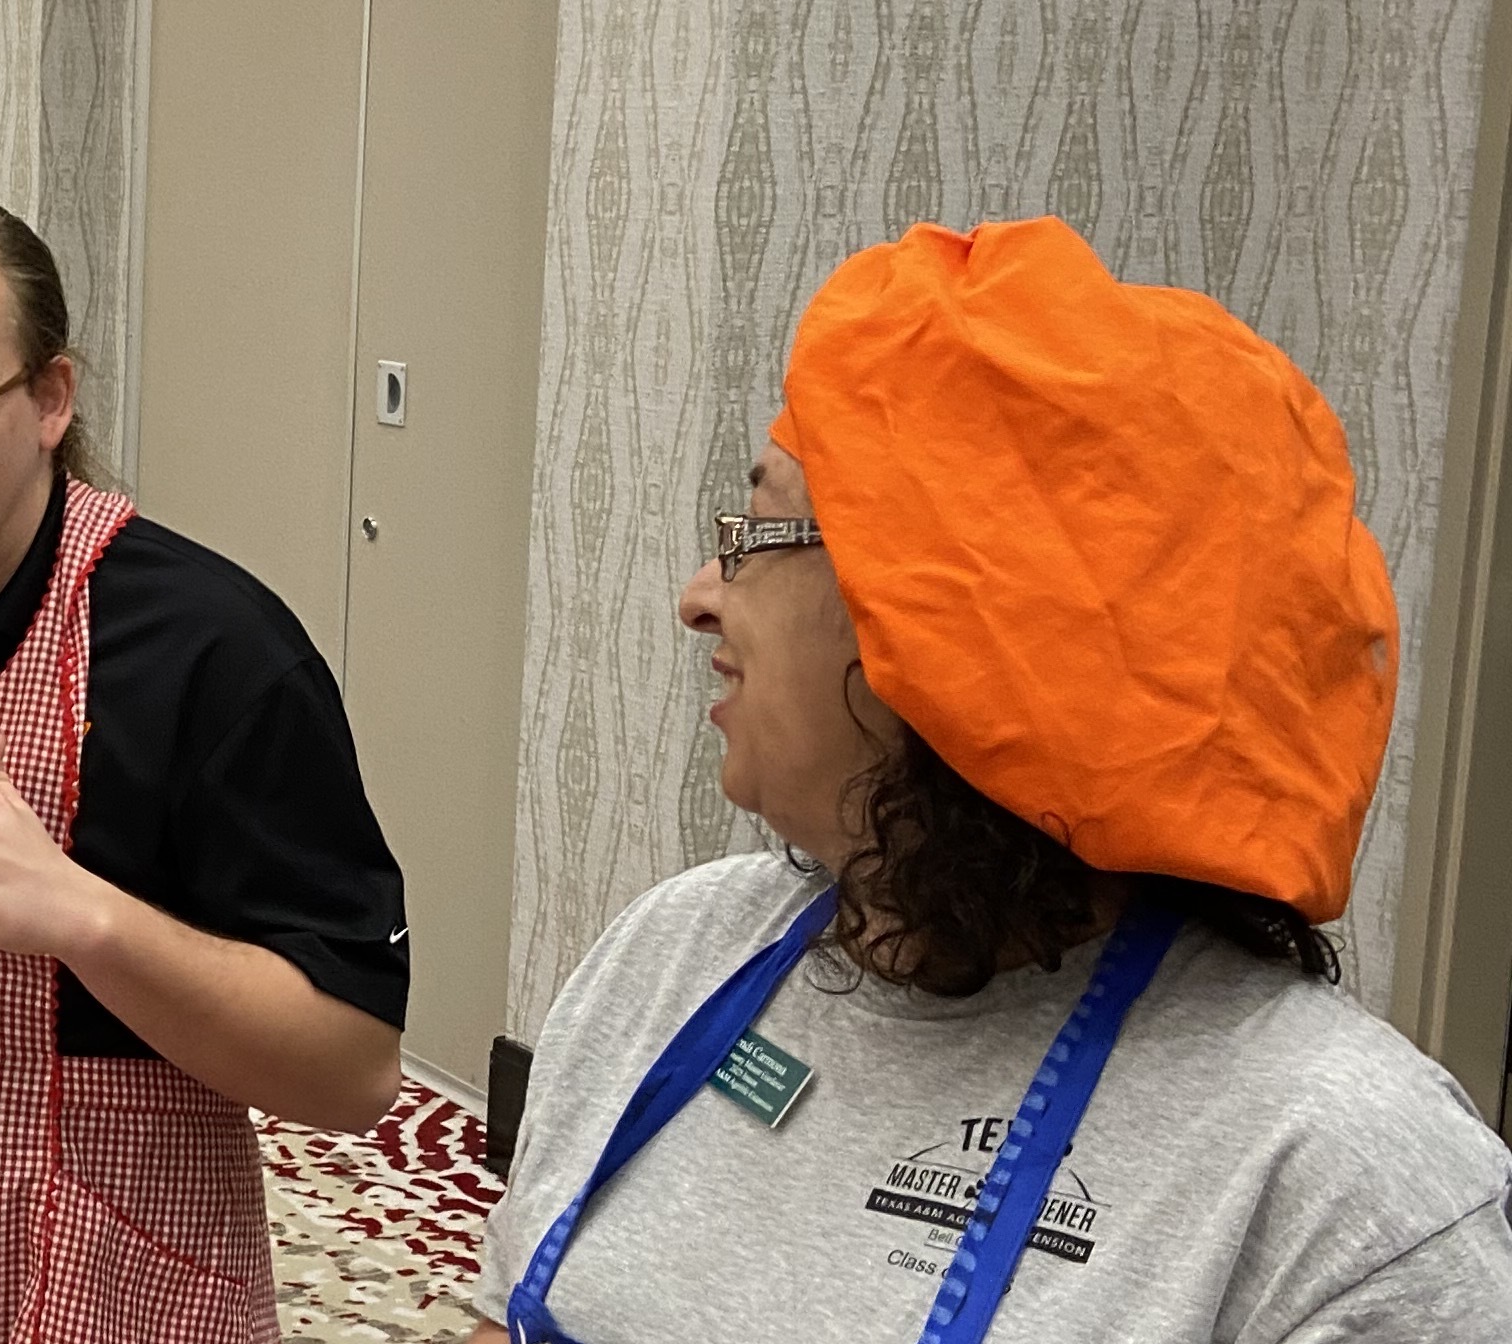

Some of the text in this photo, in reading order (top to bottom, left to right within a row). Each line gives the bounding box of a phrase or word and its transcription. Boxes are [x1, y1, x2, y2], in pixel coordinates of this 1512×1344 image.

[875, 1195, 912, 1212] TEXAS
[1031, 1232, 1087, 1257] ENSION
[886, 1163, 1097, 1233] MASTER ENER
[887, 1249, 938, 1276] Class
